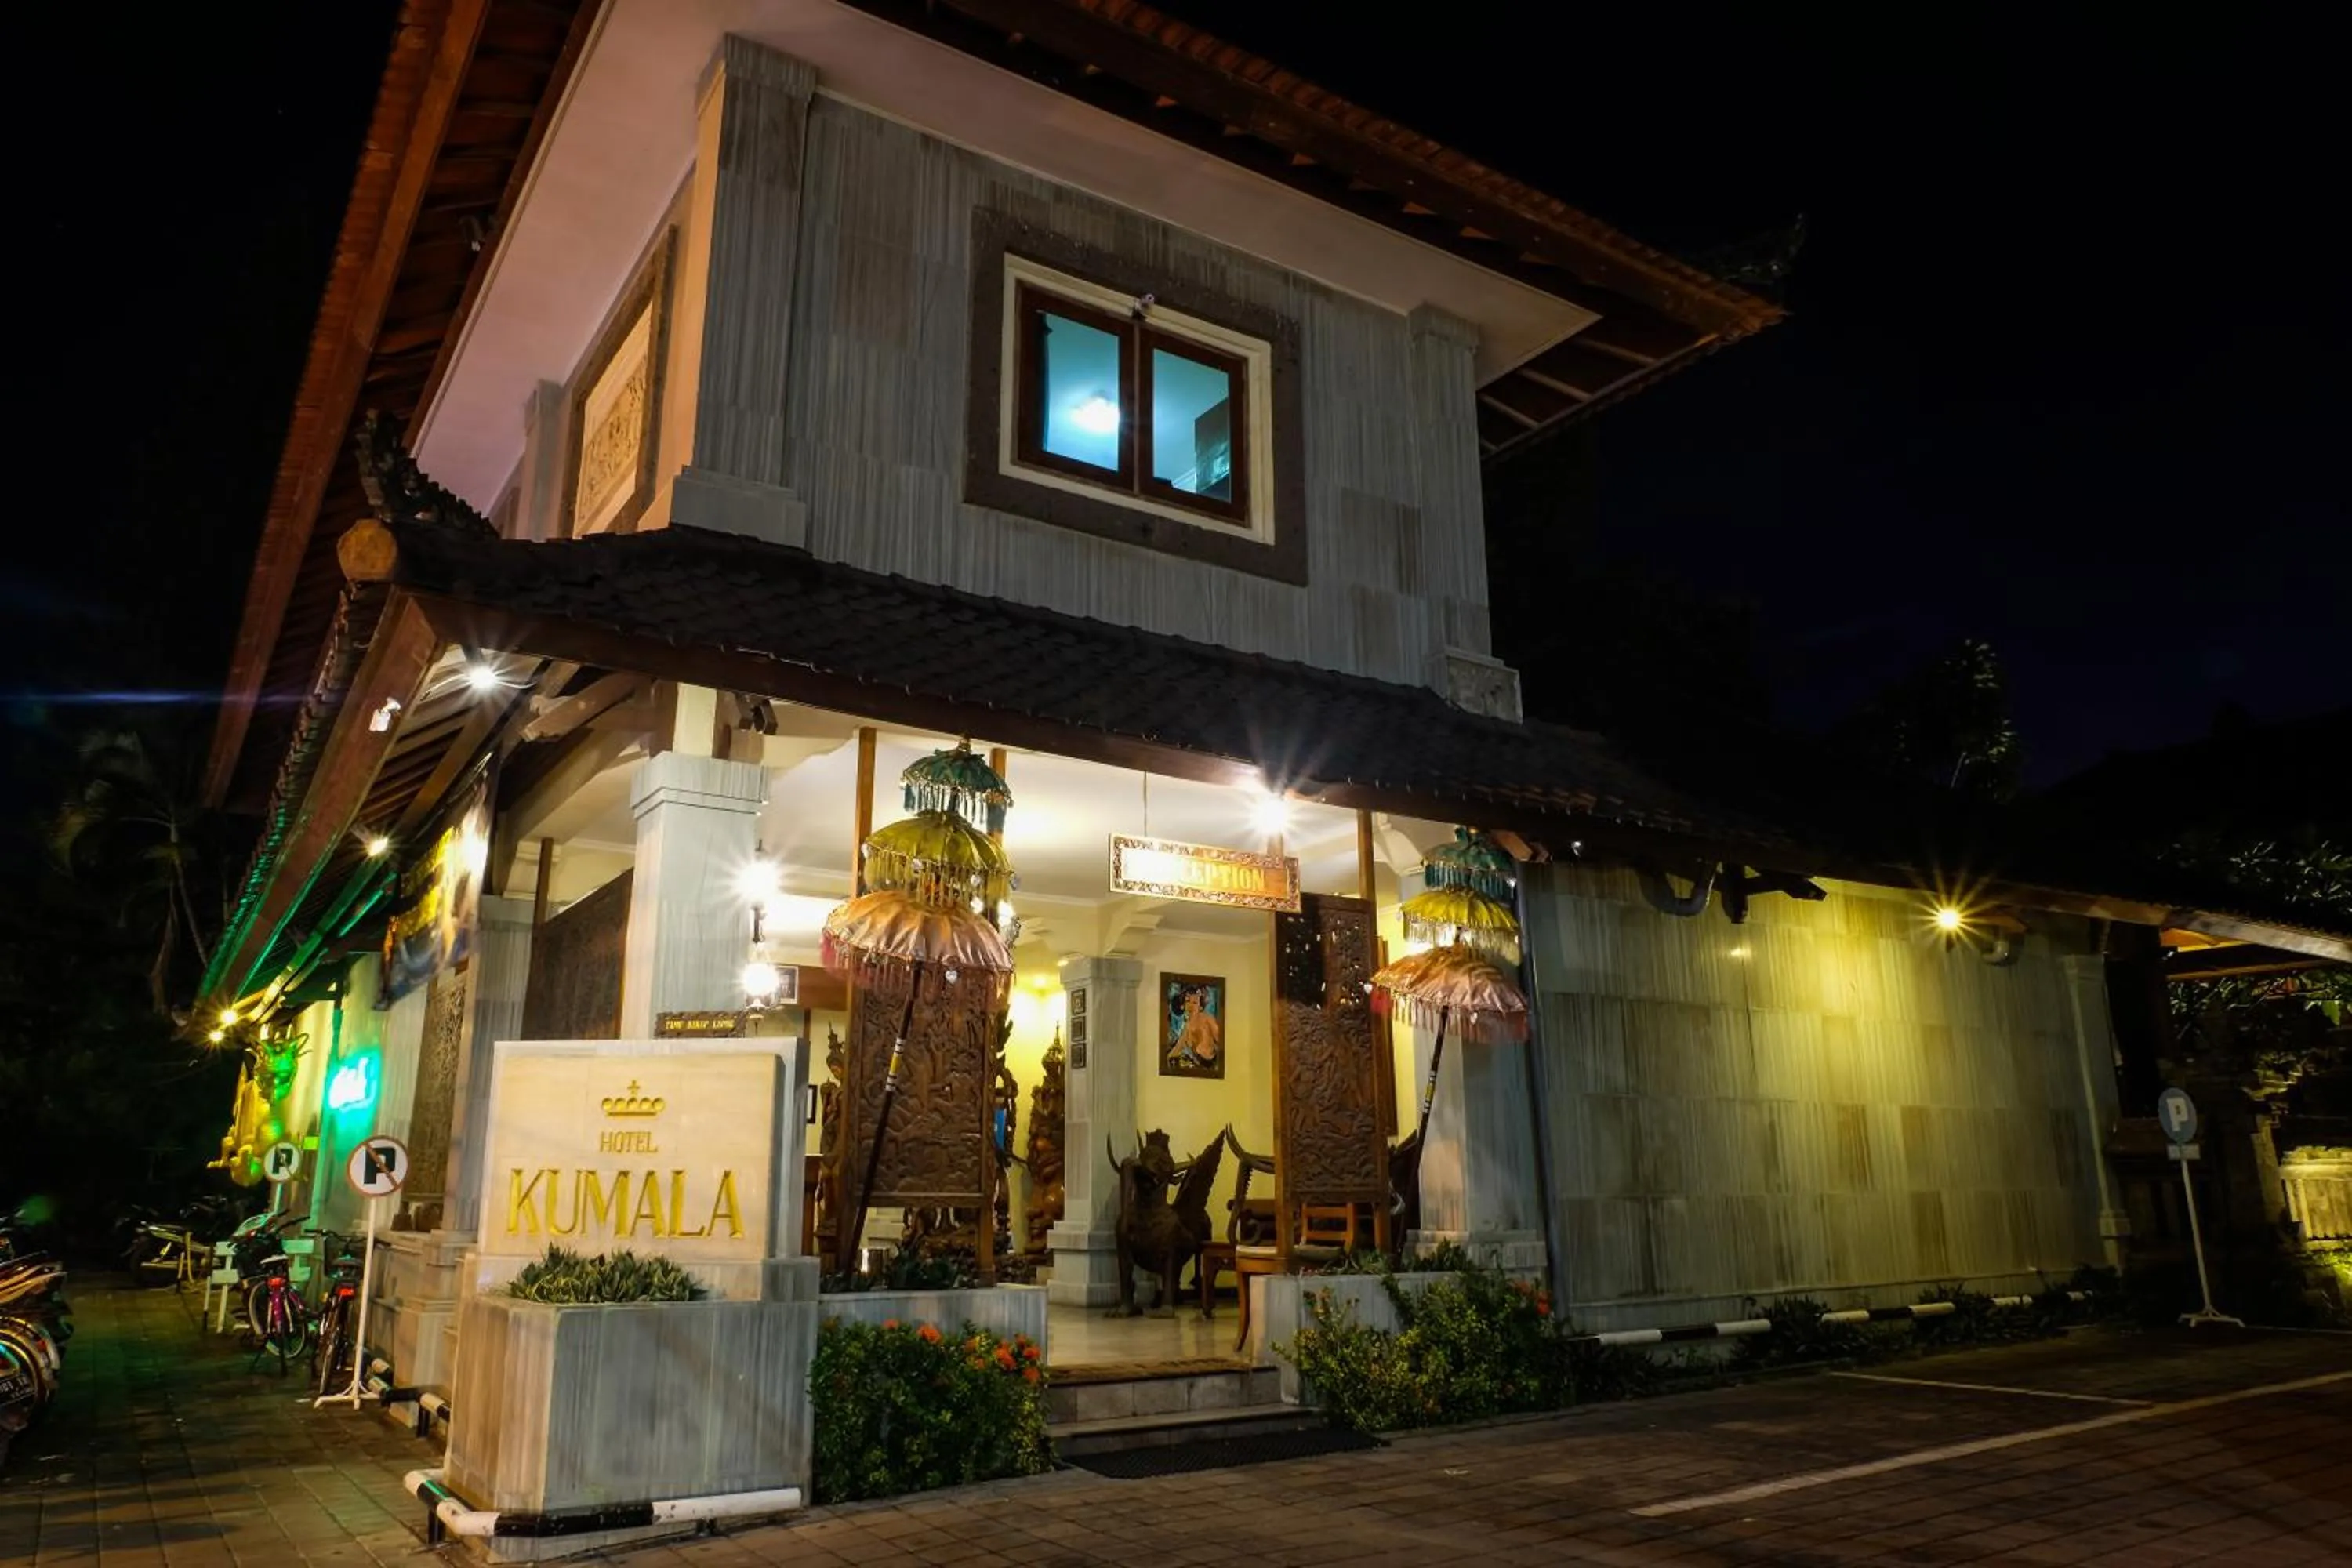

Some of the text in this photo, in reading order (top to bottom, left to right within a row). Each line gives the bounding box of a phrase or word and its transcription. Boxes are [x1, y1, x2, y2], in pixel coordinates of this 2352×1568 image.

[2166, 1098, 2188, 1131] P
[600, 1131, 658, 1153] HOTEL
[272, 1148, 293, 1174] P
[363, 1147, 396, 1184] P
[507, 1168, 742, 1238] KUMALA
